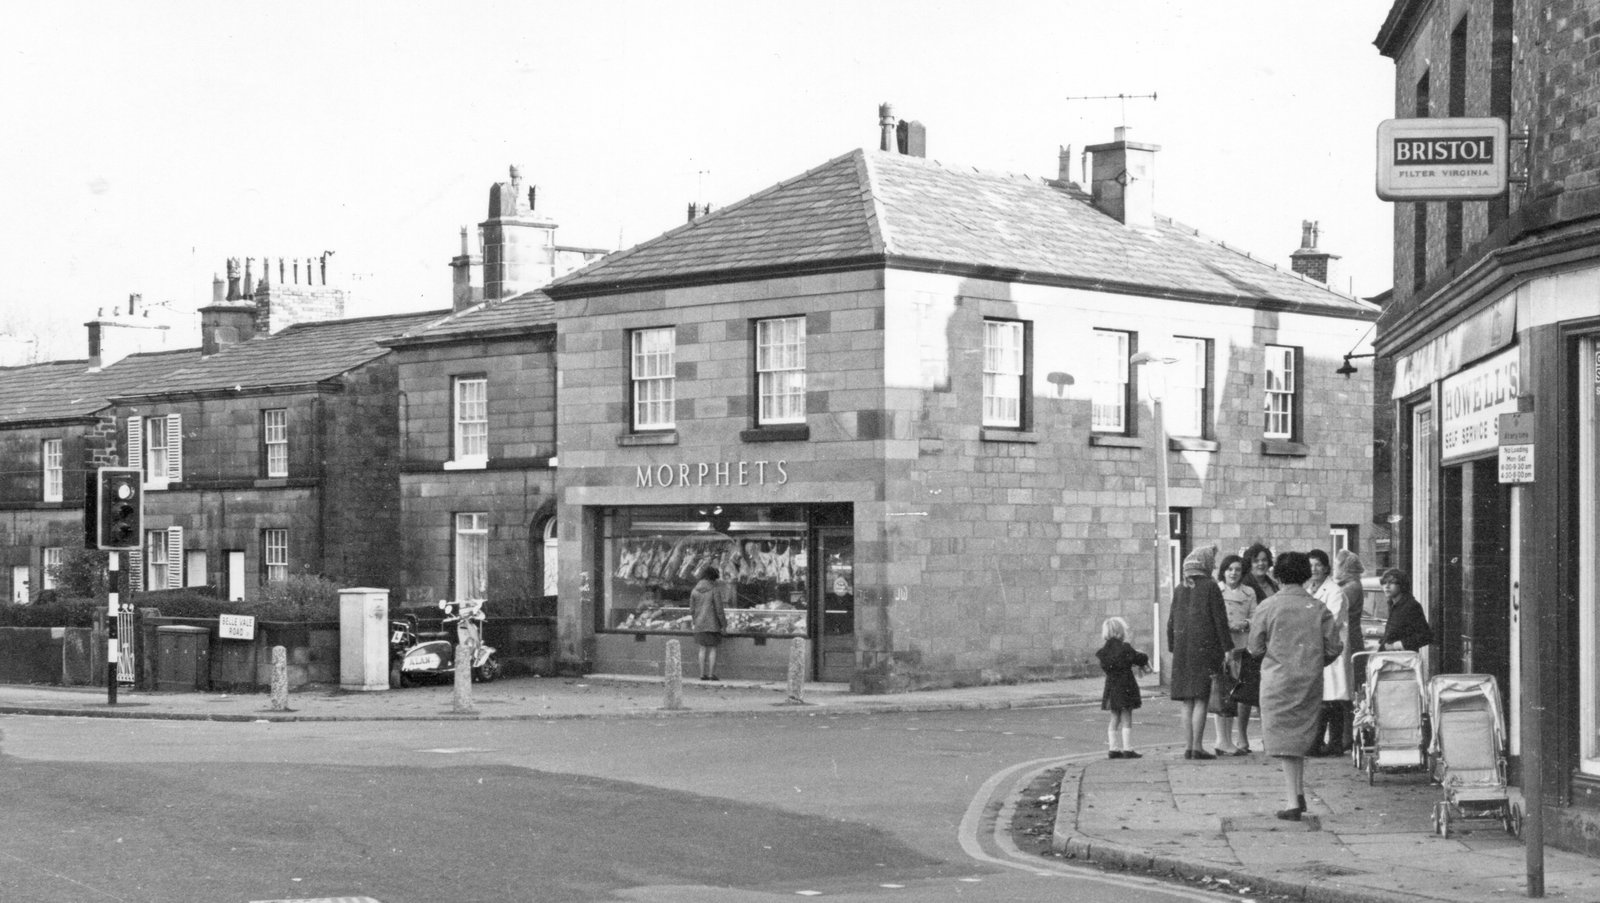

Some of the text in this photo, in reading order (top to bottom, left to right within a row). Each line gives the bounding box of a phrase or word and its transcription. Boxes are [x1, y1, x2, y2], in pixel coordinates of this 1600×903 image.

[1396, 141, 1491, 161] BRISTOL
[1399, 169, 1489, 178] FILTER VIRGINIA
[1445, 361, 1518, 421] HOWELL'S
[636, 459, 788, 487] MORPHETS
[222, 616, 253, 627] BELLE VALE
[229, 627, 244, 636] ROAD
